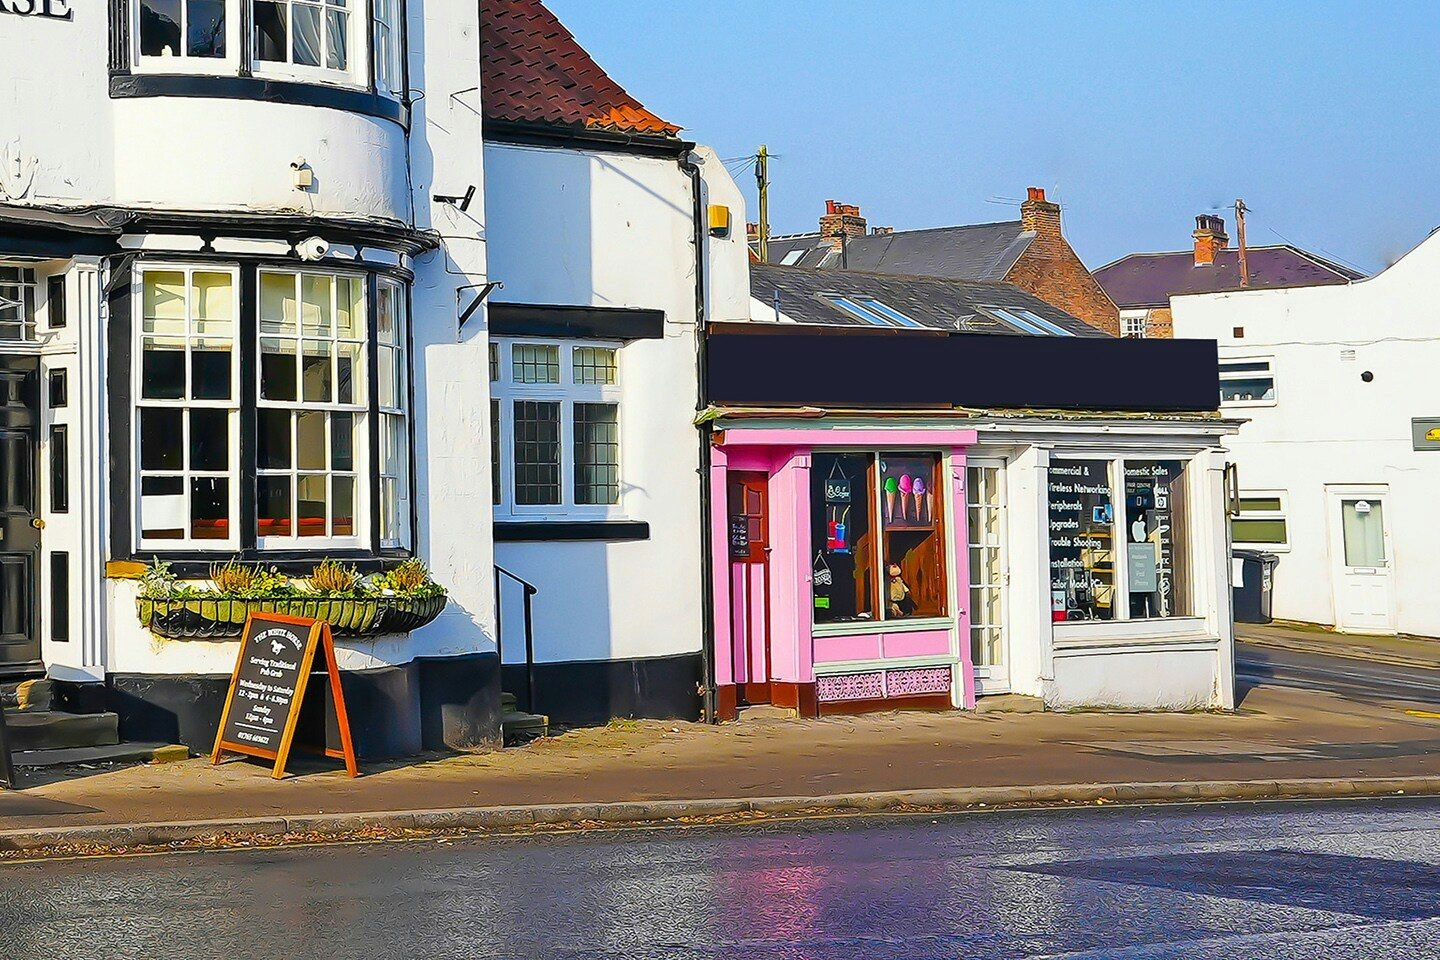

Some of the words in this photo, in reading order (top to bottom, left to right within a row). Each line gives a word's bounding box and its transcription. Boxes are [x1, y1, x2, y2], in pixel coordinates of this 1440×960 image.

[1049, 466, 1081, 475] ommercial
[1083, 466, 1089, 476] &
[1151, 465, 1169, 476] Sales
[1074, 482, 1112, 497] Networking
[1050, 536, 1071, 546] rouble
[1073, 536, 1102, 550] Shooting
[1051, 557, 1084, 568] nstallation
[1050, 579, 1067, 589] ailor
[254, 630, 268, 644] THE
[250, 656, 269, 668] Serving
[269, 659, 297, 670] Traditional
[260, 667, 270, 676] Pub
[270, 669, 283, 678] Grub
[240, 679, 267, 693] Wednesday
[267, 684, 273, 692] to
[273, 685, 294, 697] Saturday
[252, 704, 271, 716] Sunday
